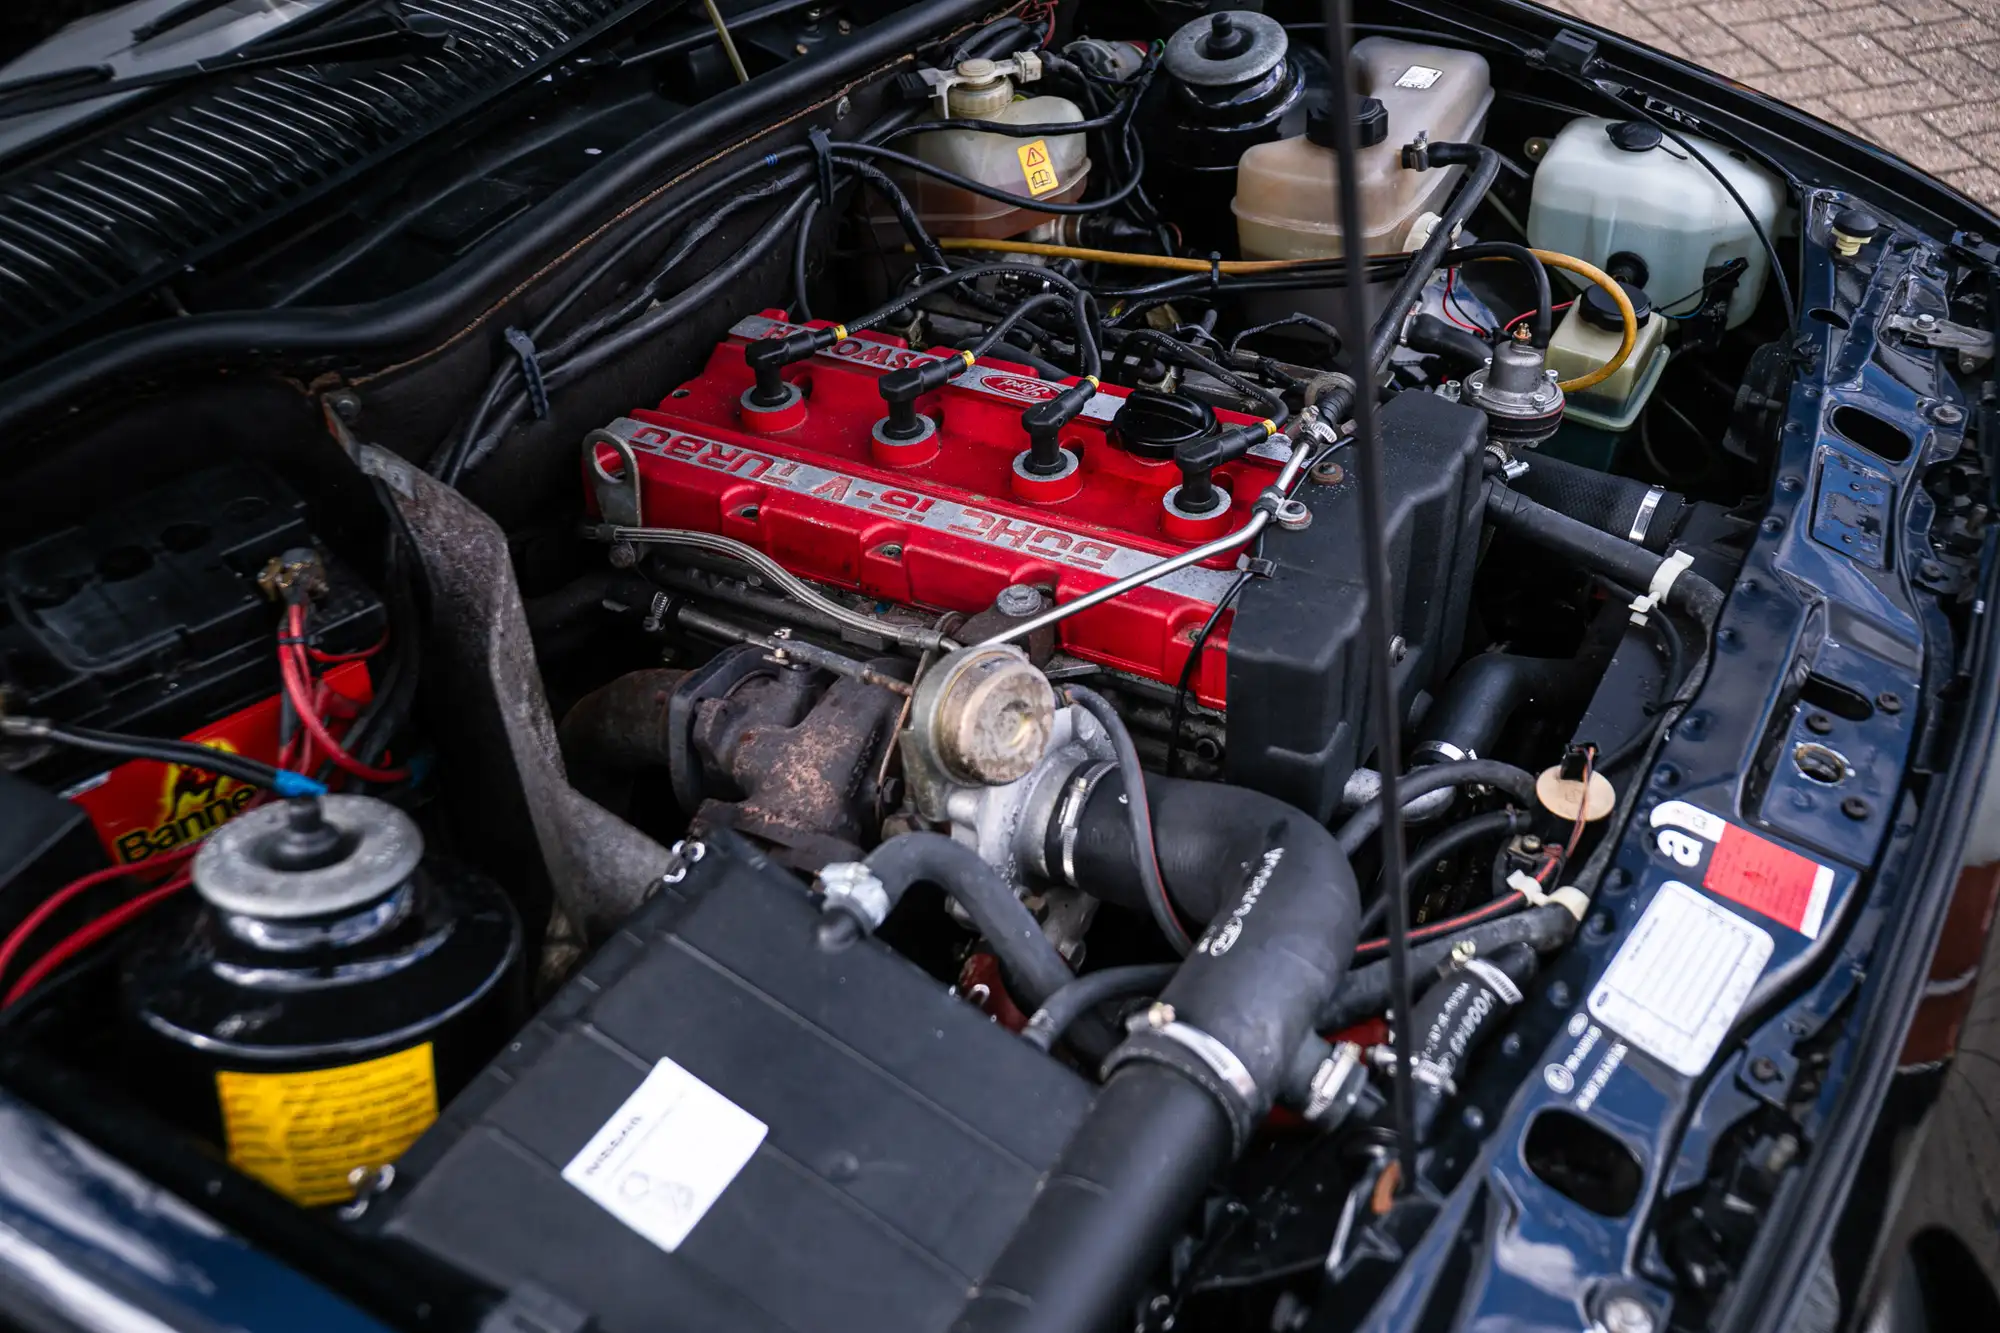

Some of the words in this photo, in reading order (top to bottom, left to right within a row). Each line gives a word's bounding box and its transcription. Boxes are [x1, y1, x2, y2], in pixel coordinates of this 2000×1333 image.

[628, 426, 800, 486] TURBO
[811, 475, 936, 523] 16-V
[947, 508, 1118, 570] DOHC
[115, 784, 258, 865] Banne
